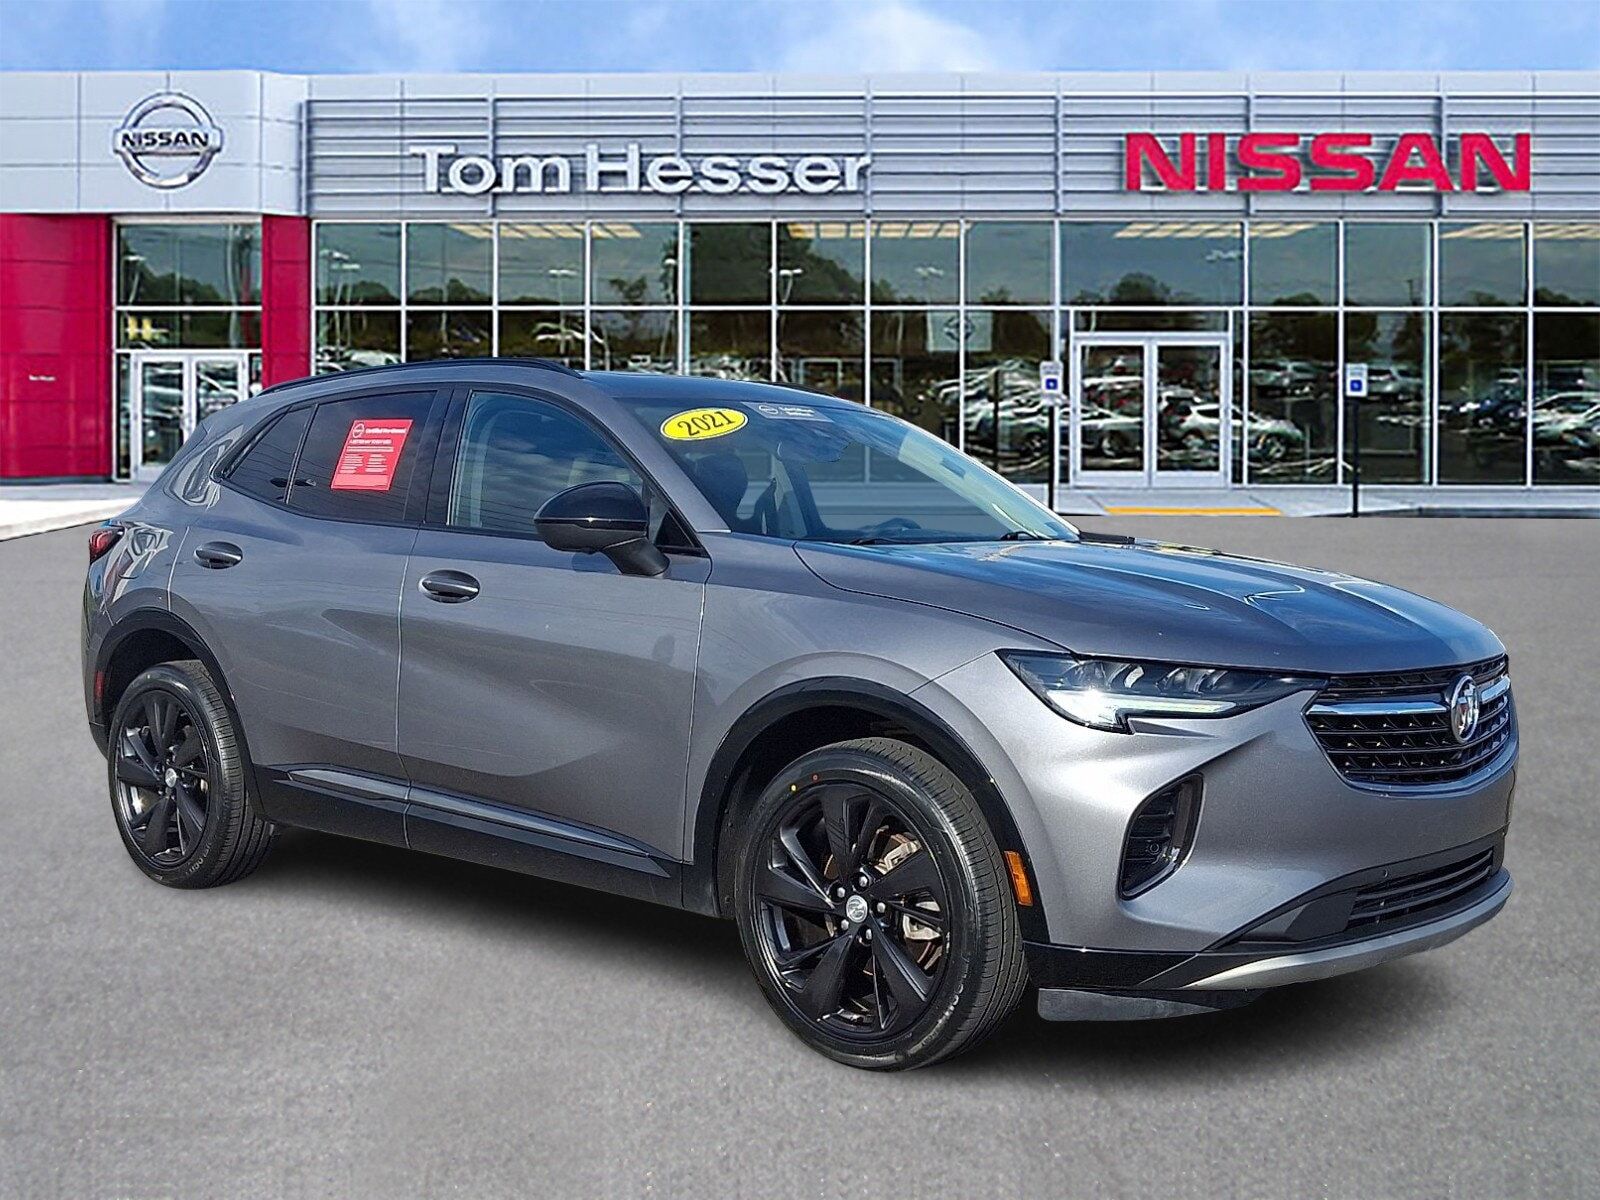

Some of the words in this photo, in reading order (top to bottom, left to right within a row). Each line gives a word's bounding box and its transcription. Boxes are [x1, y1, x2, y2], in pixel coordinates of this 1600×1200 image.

[121, 131, 209, 147] NISSAN
[409, 145, 571, 193] Tom
[585, 143, 871, 193] Hesser
[1125, 132, 1531, 191] NISSAN
[678, 410, 736, 437] 2021
